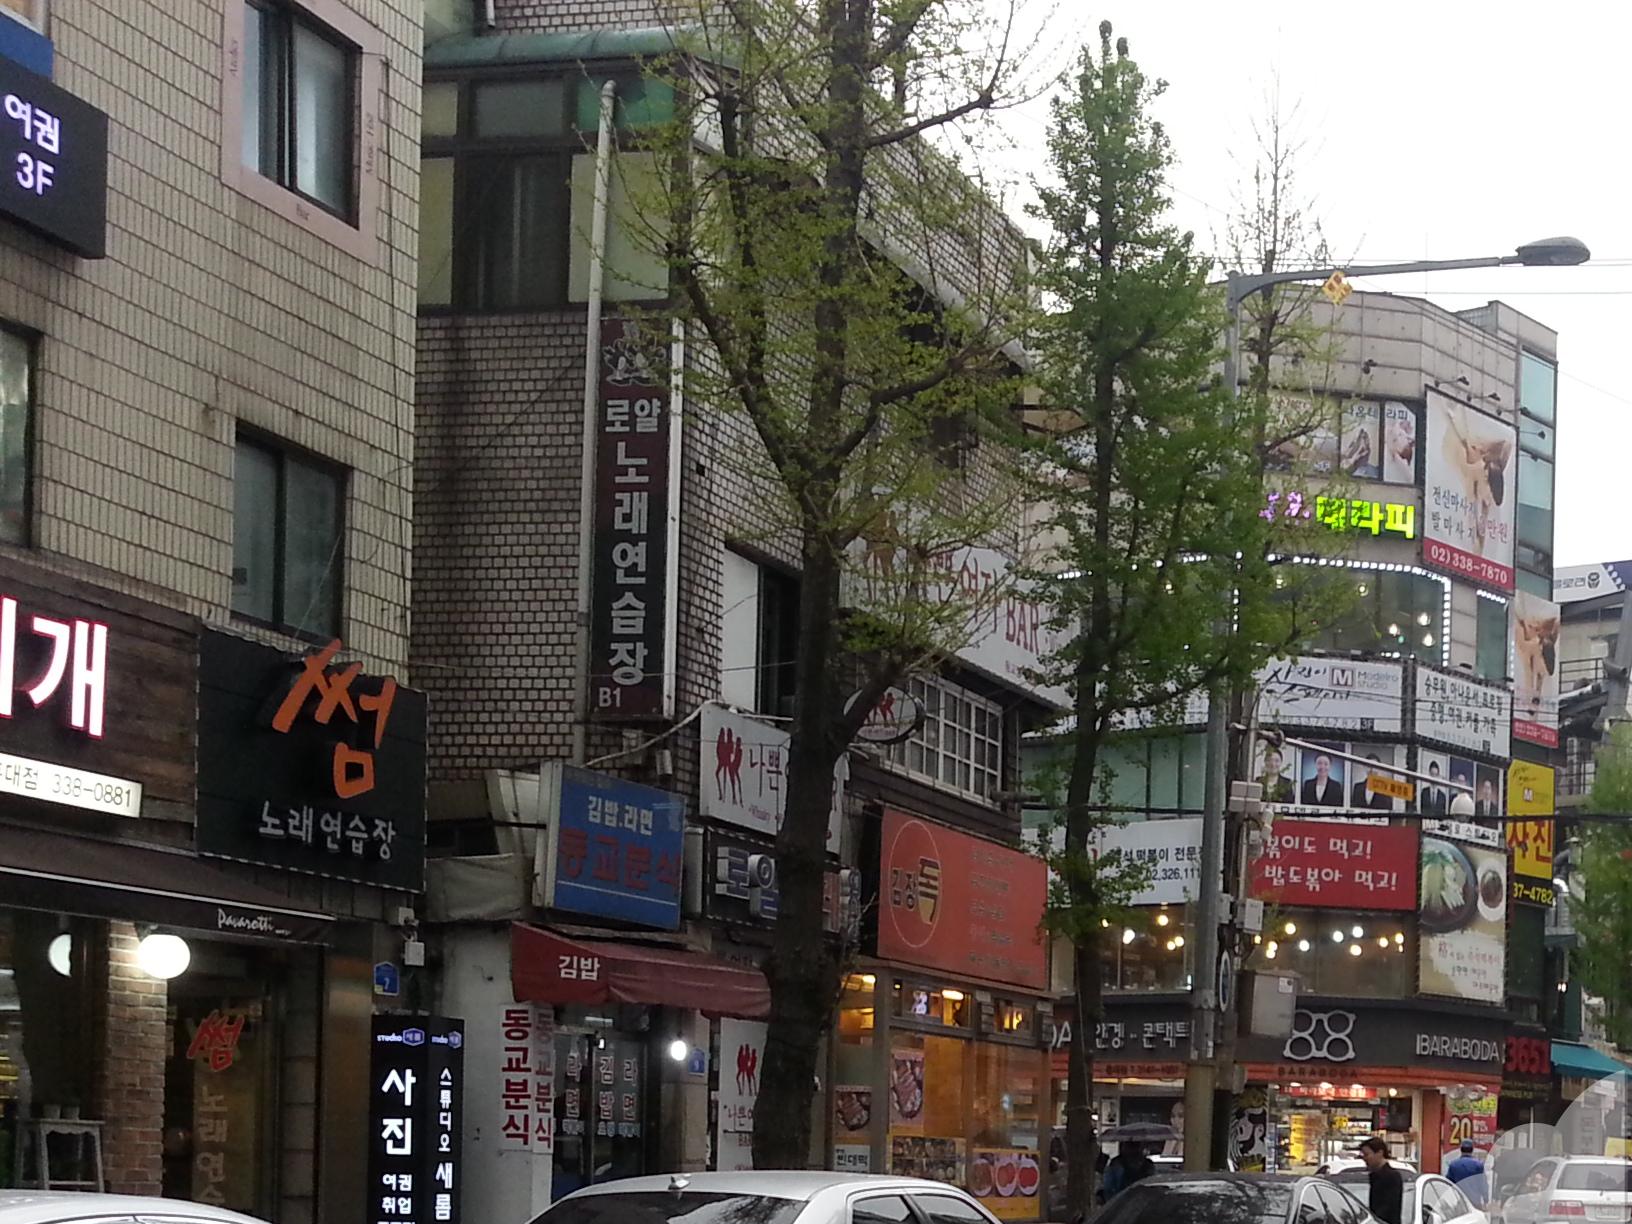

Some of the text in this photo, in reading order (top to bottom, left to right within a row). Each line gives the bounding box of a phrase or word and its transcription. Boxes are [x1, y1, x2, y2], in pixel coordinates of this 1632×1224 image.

[4, 94, 60, 154] 여권
[16, 152, 54, 195] 3F
[605, 399, 661, 432] 로얄
[608, 441, 650, 687] 노래연습장
[1430, 545, 1508, 585] 02)338-7870
[598, 687, 622, 708] B1
[272, 638, 397, 799] 썸
[52, 774, 132, 808] 338-0881
[259, 801, 397, 860] 노래연습장
[588, 796, 653, 836] 김밥.라면
[560, 828, 681, 892] 동교분식
[1175, 846, 1203, 862] 전문
[1329, 838, 1372, 860] 먹고!
[1508, 818, 1552, 864] 사진
[1354, 870, 1397, 892] 먹고!
[558, 955, 601, 982] 김밥
[1143, 1021, 1190, 1049] 콘택트
[1420, 1033, 1500, 1061] BARABODA
[501, 1009, 532, 1146] 동교분식
[381, 1068, 417, 1156] 사진
[382, 1173, 413, 1192] 여권
[435, 1162, 454, 1221] 새롬
[382, 1196, 412, 1215] 취업
